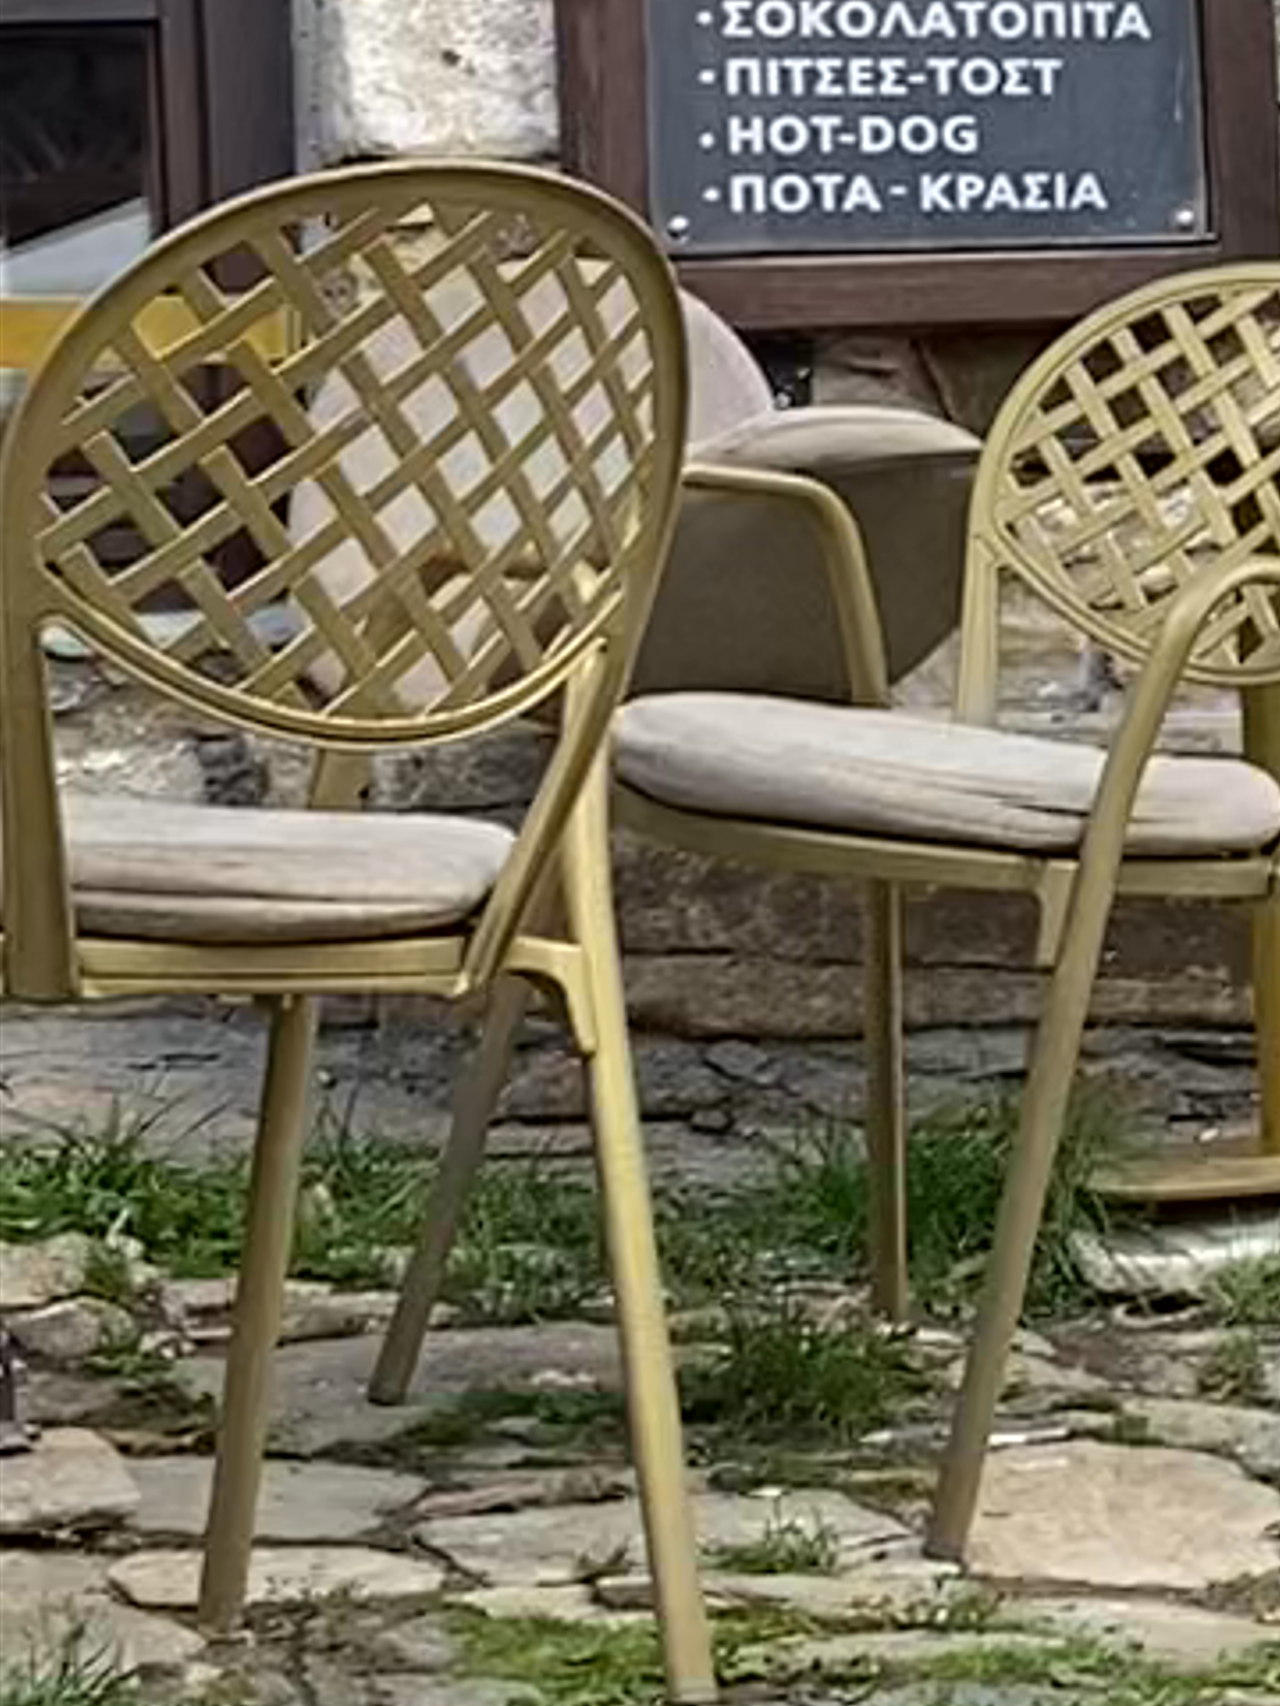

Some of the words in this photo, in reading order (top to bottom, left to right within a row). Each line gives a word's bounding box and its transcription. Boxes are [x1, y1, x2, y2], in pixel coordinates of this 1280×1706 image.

[726, 57, 1064, 97] ΠΙΤΣΕΣ-ΤΟΣΤ
[729, 115, 979, 155] HOT-DOG
[730, 173, 882, 213] ΠΟΤΑ
[920, 172, 1108, 211] ΚΡΑΣΙΑ
